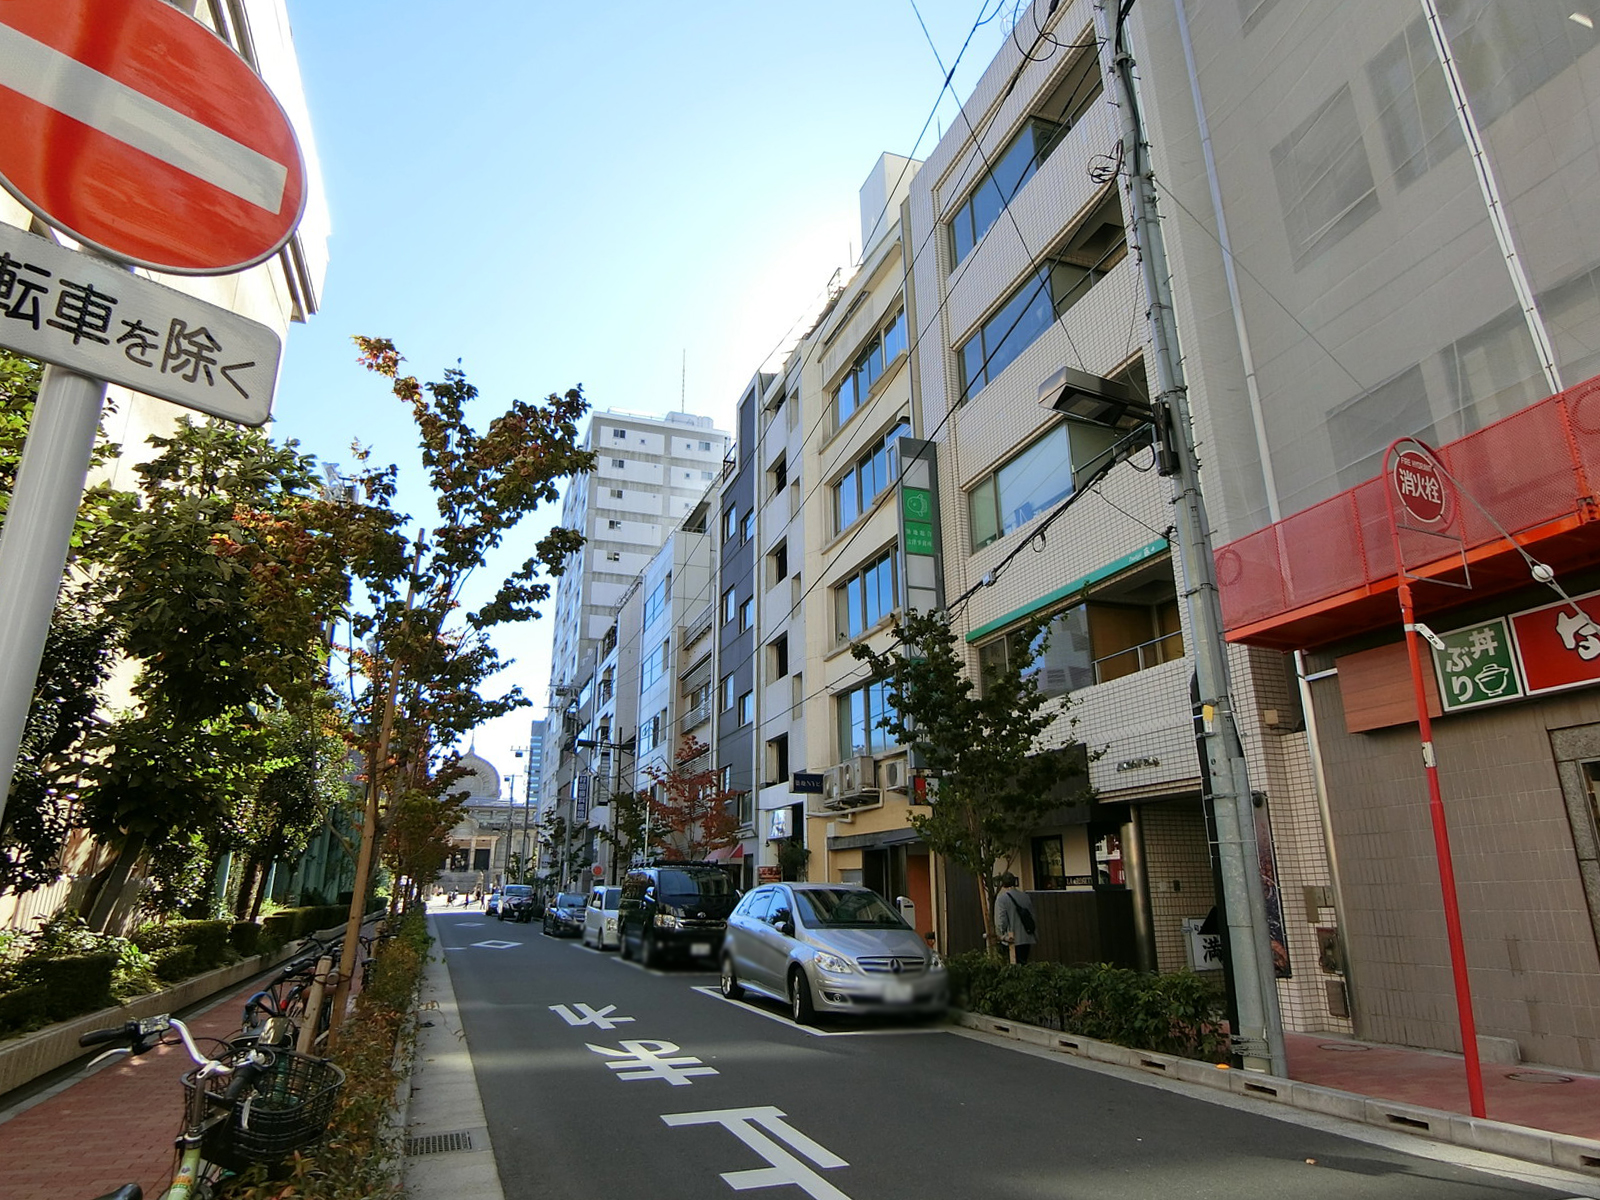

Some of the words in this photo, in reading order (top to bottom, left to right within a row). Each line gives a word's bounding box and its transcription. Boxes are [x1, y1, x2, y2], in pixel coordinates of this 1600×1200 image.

[1400, 457, 1412, 467] FIRE
[1398, 468, 1441, 503] 消火栓
